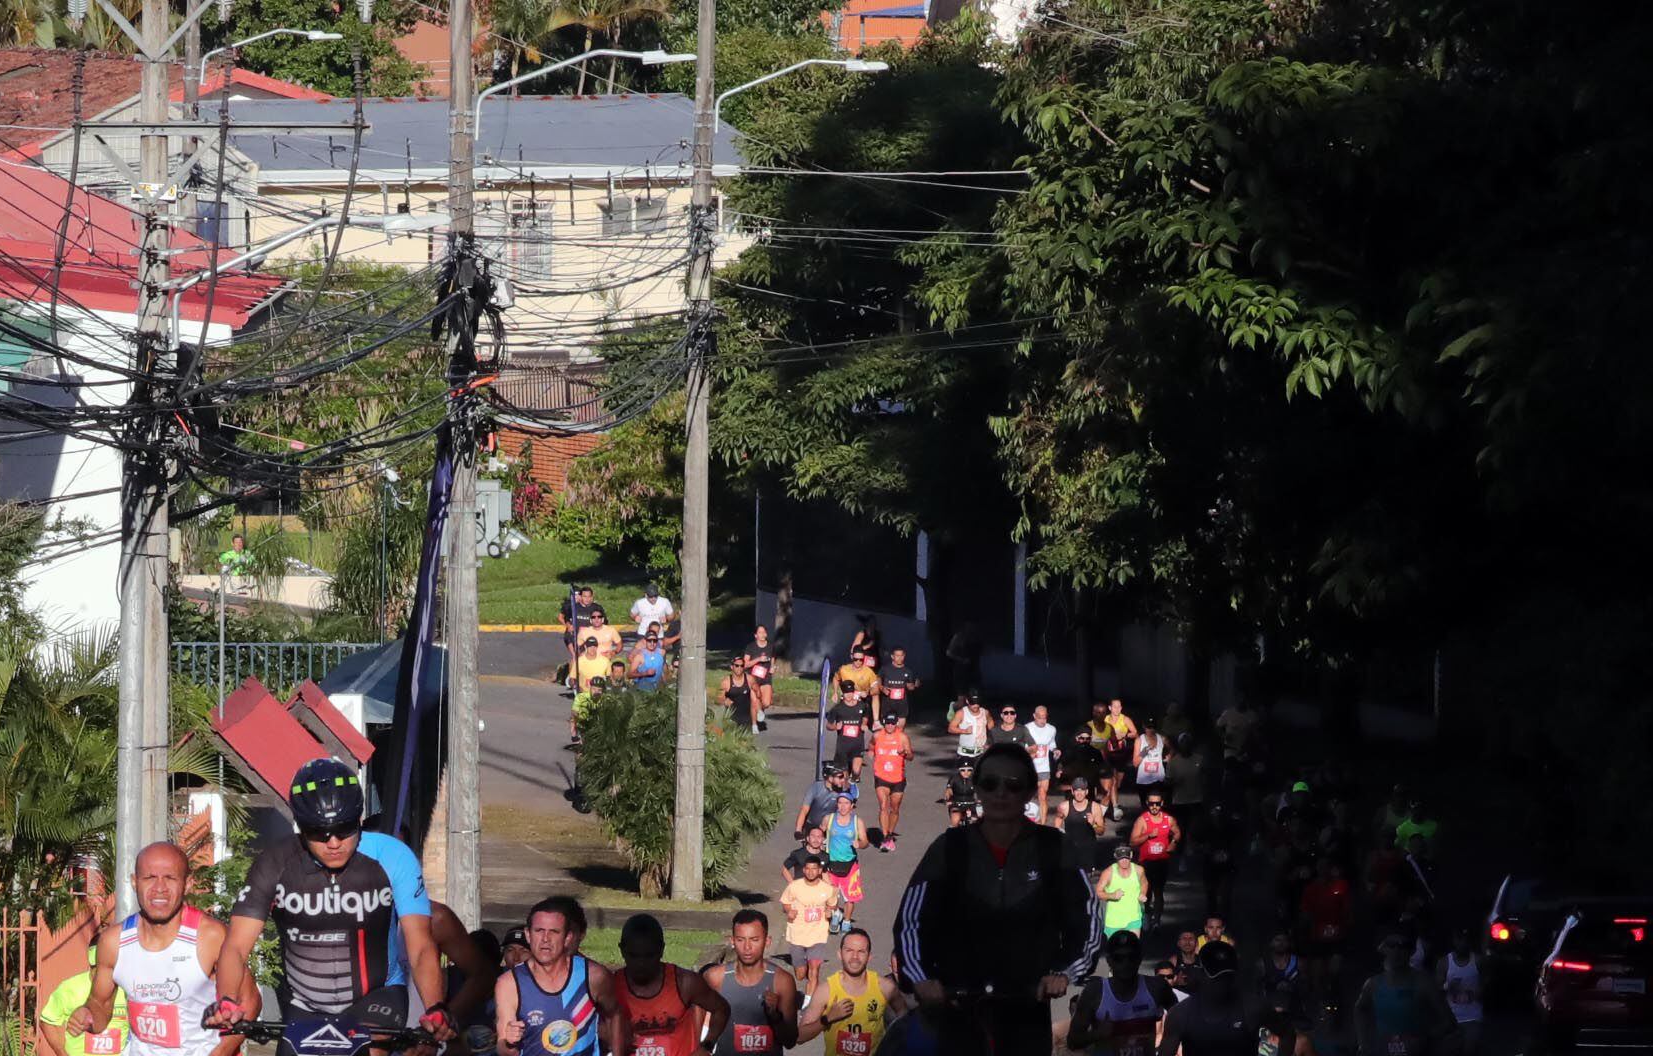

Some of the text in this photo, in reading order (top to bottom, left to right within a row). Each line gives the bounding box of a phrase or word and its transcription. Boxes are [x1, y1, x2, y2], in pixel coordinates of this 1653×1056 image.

[275, 884, 392, 922] Boutique
[299, 933, 346, 942] CUBE
[92, 1037, 114, 1050] 720
[740, 1034, 768, 1047] 1021
[841, 1040, 867, 1053] 1326
